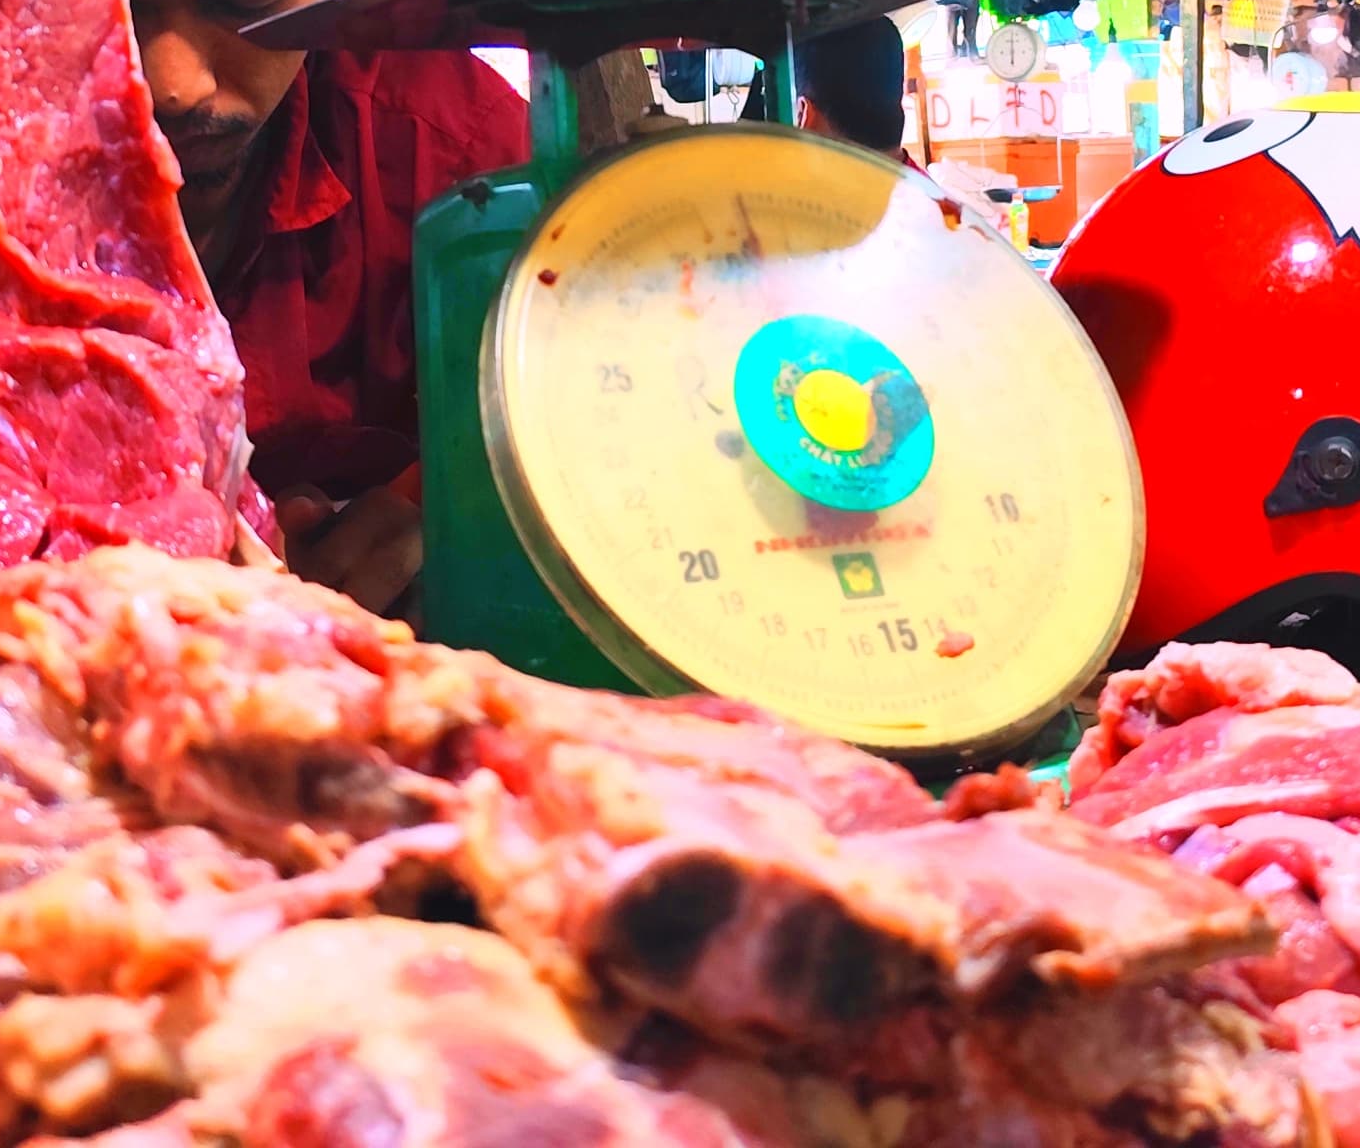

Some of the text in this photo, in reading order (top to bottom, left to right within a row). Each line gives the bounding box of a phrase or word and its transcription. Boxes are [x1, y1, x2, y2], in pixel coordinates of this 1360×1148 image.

[596, 364, 632, 393] 25
[984, 492, 1020, 523] 10
[678, 549, 720, 583] 20
[759, 611, 788, 638] 18
[803, 627, 829, 651] 17
[877, 618, 919, 653] 15
[847, 634, 875, 658] 16
